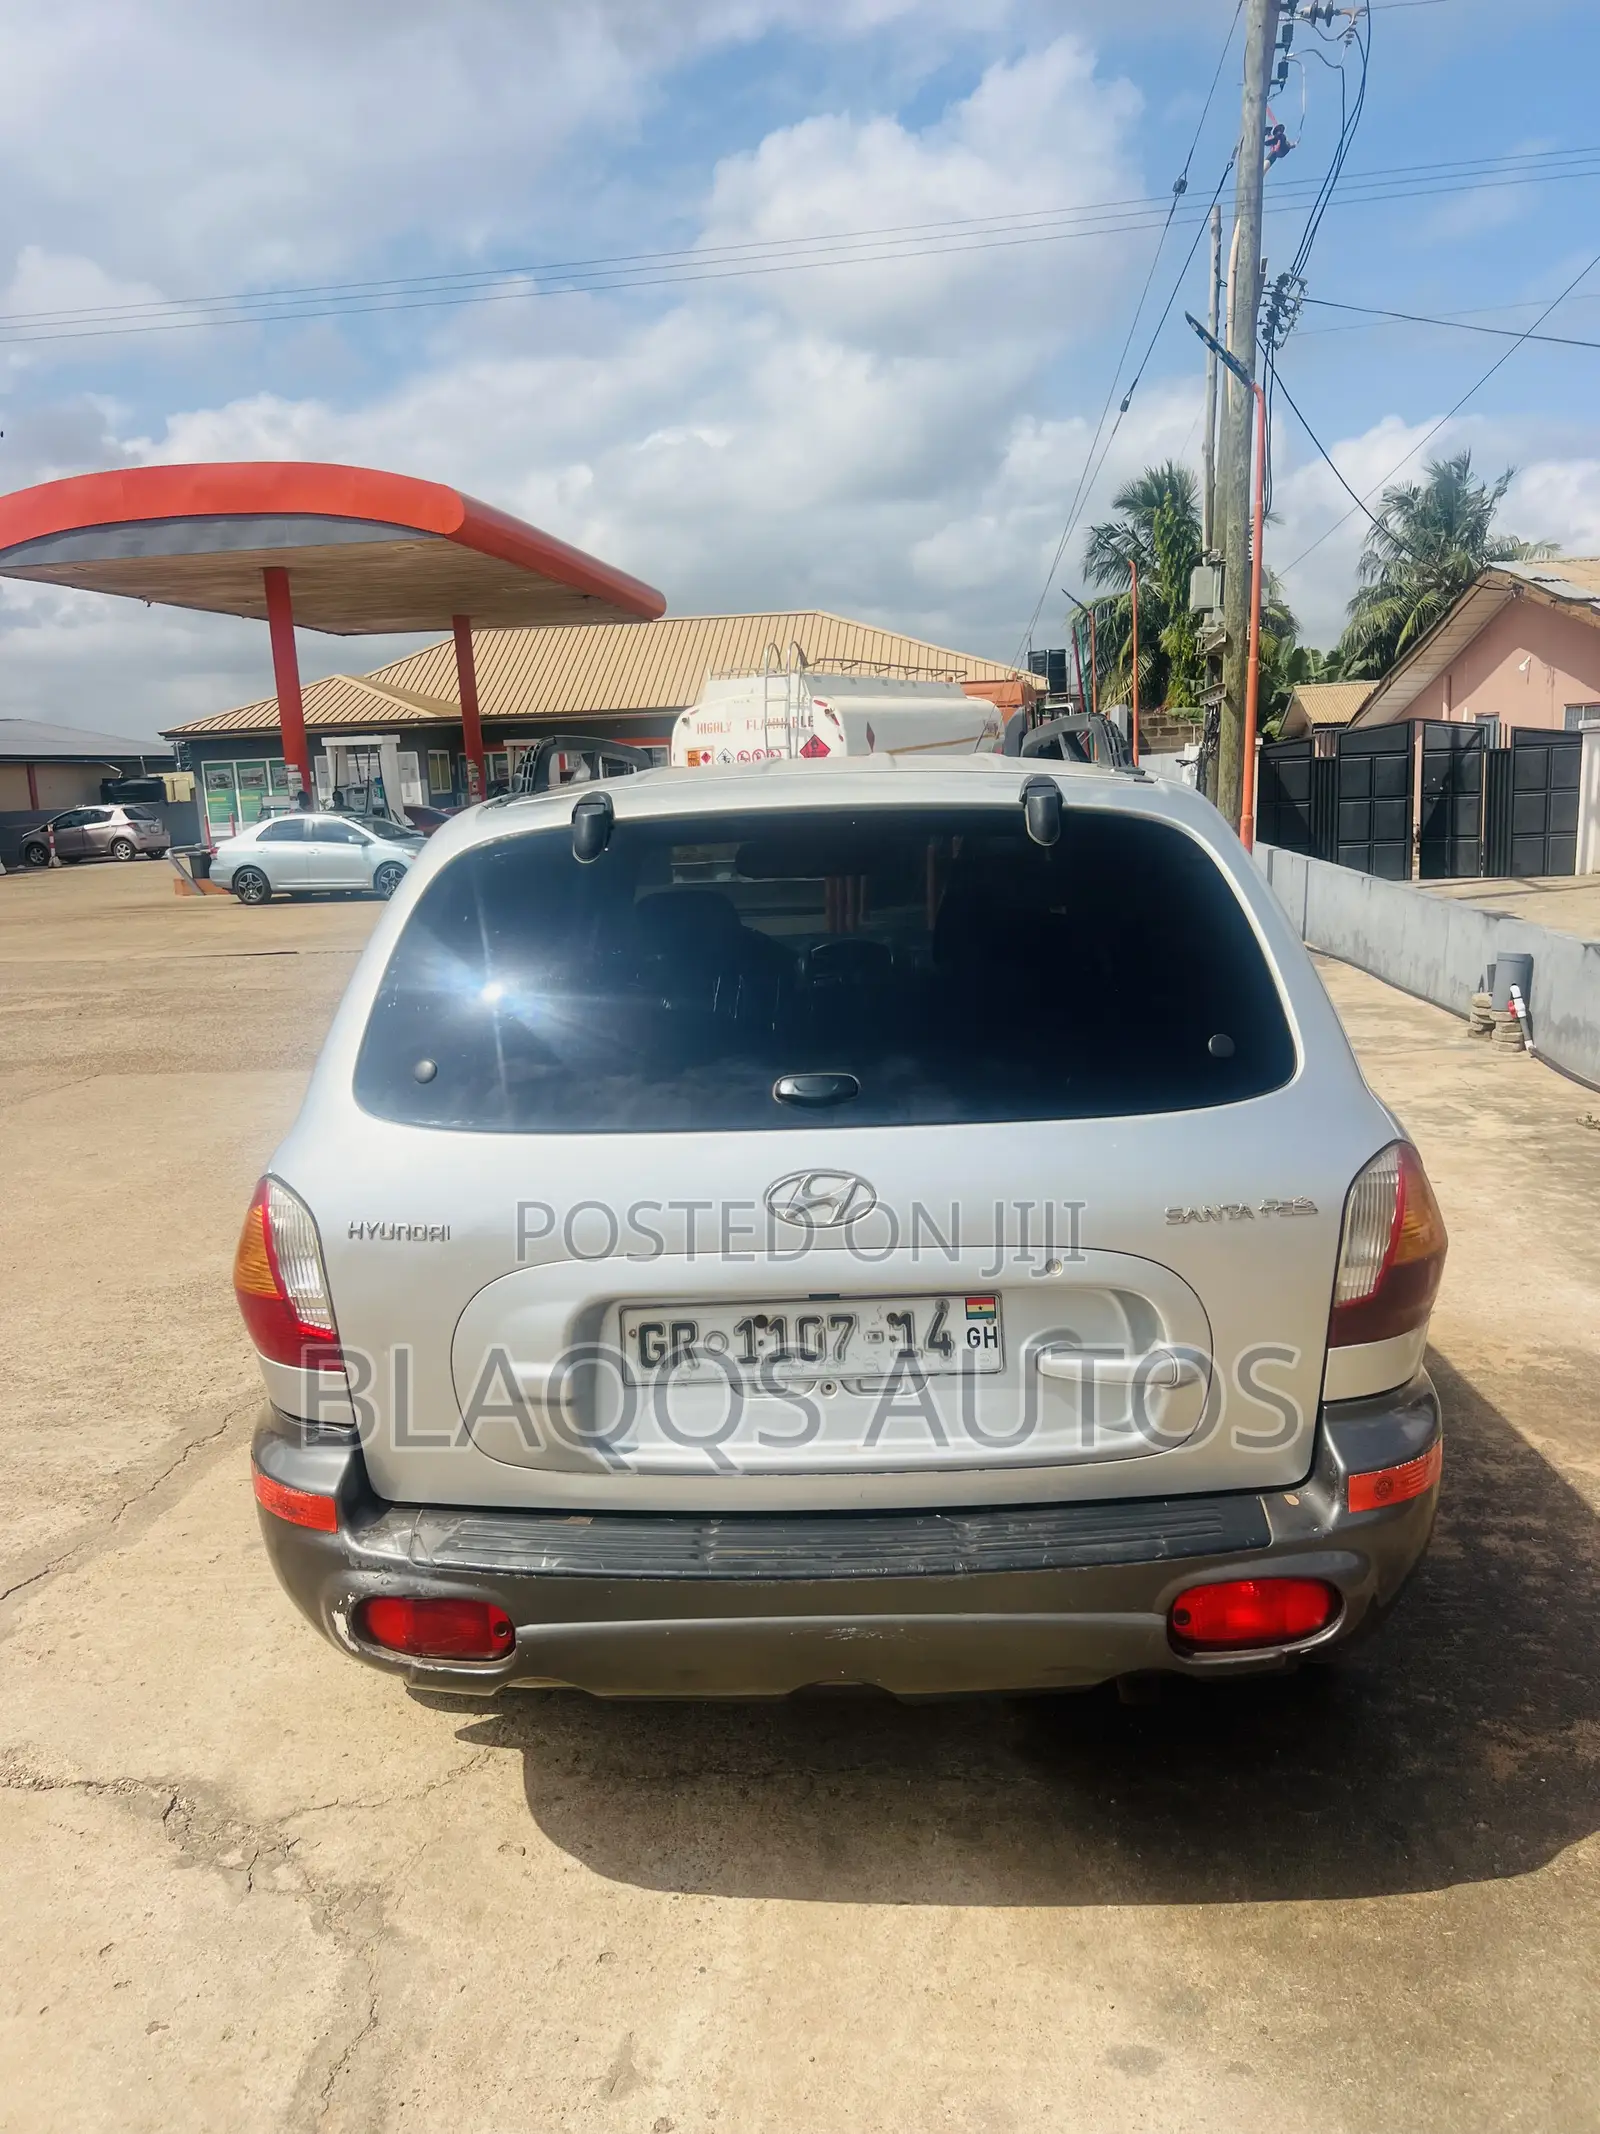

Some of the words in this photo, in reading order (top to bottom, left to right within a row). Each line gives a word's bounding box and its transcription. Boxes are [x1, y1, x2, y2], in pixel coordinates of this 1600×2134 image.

[696, 721, 732, 735] HIGHLY
[1165, 1203, 1254, 1225] SANTA
[348, 1221, 450, 1243] HYUNDAI
[638, 1321, 699, 1370] GR
[966, 1327, 1000, 1350] GH
